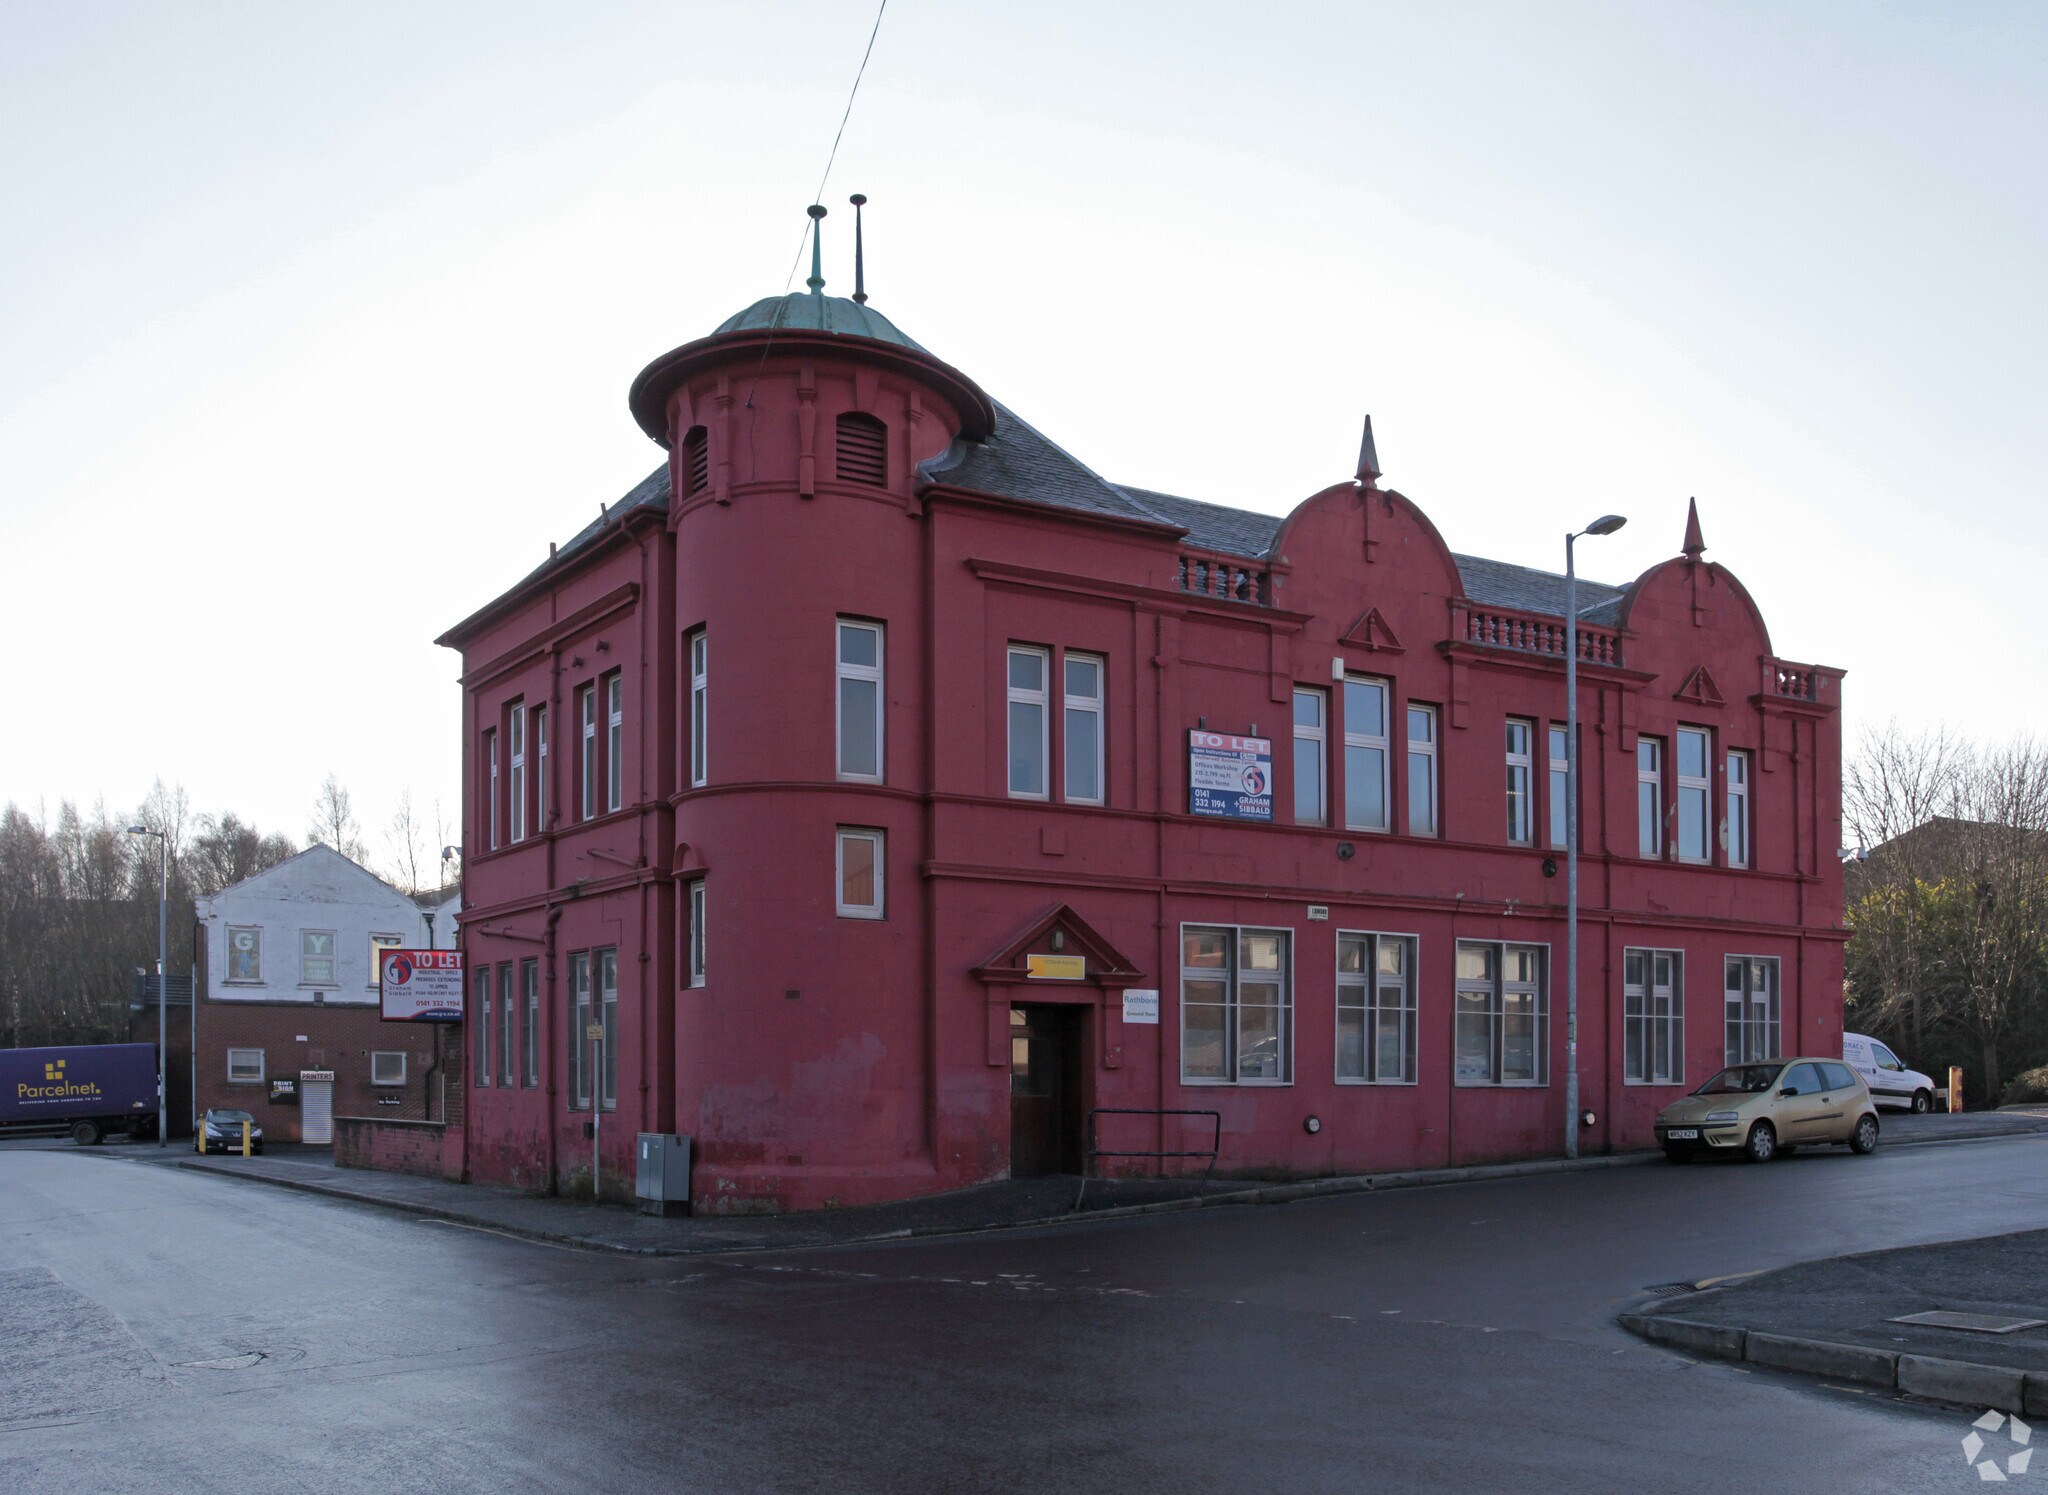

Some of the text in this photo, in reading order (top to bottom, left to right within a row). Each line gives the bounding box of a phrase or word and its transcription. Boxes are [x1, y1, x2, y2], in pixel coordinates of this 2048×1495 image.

[1193, 733, 1268, 752] TO LET
[1194, 789, 1210, 798] 0141
[1194, 798, 1226, 809] 332 1194
[1239, 796, 1270, 806] GRAHAM
[1239, 805, 1270, 815] SIBBALD
[234, 932, 254, 951] G
[309, 935, 328, 953] Y
[413, 952, 463, 968] TO LET
[1124, 996, 1157, 1004] Rathbone
